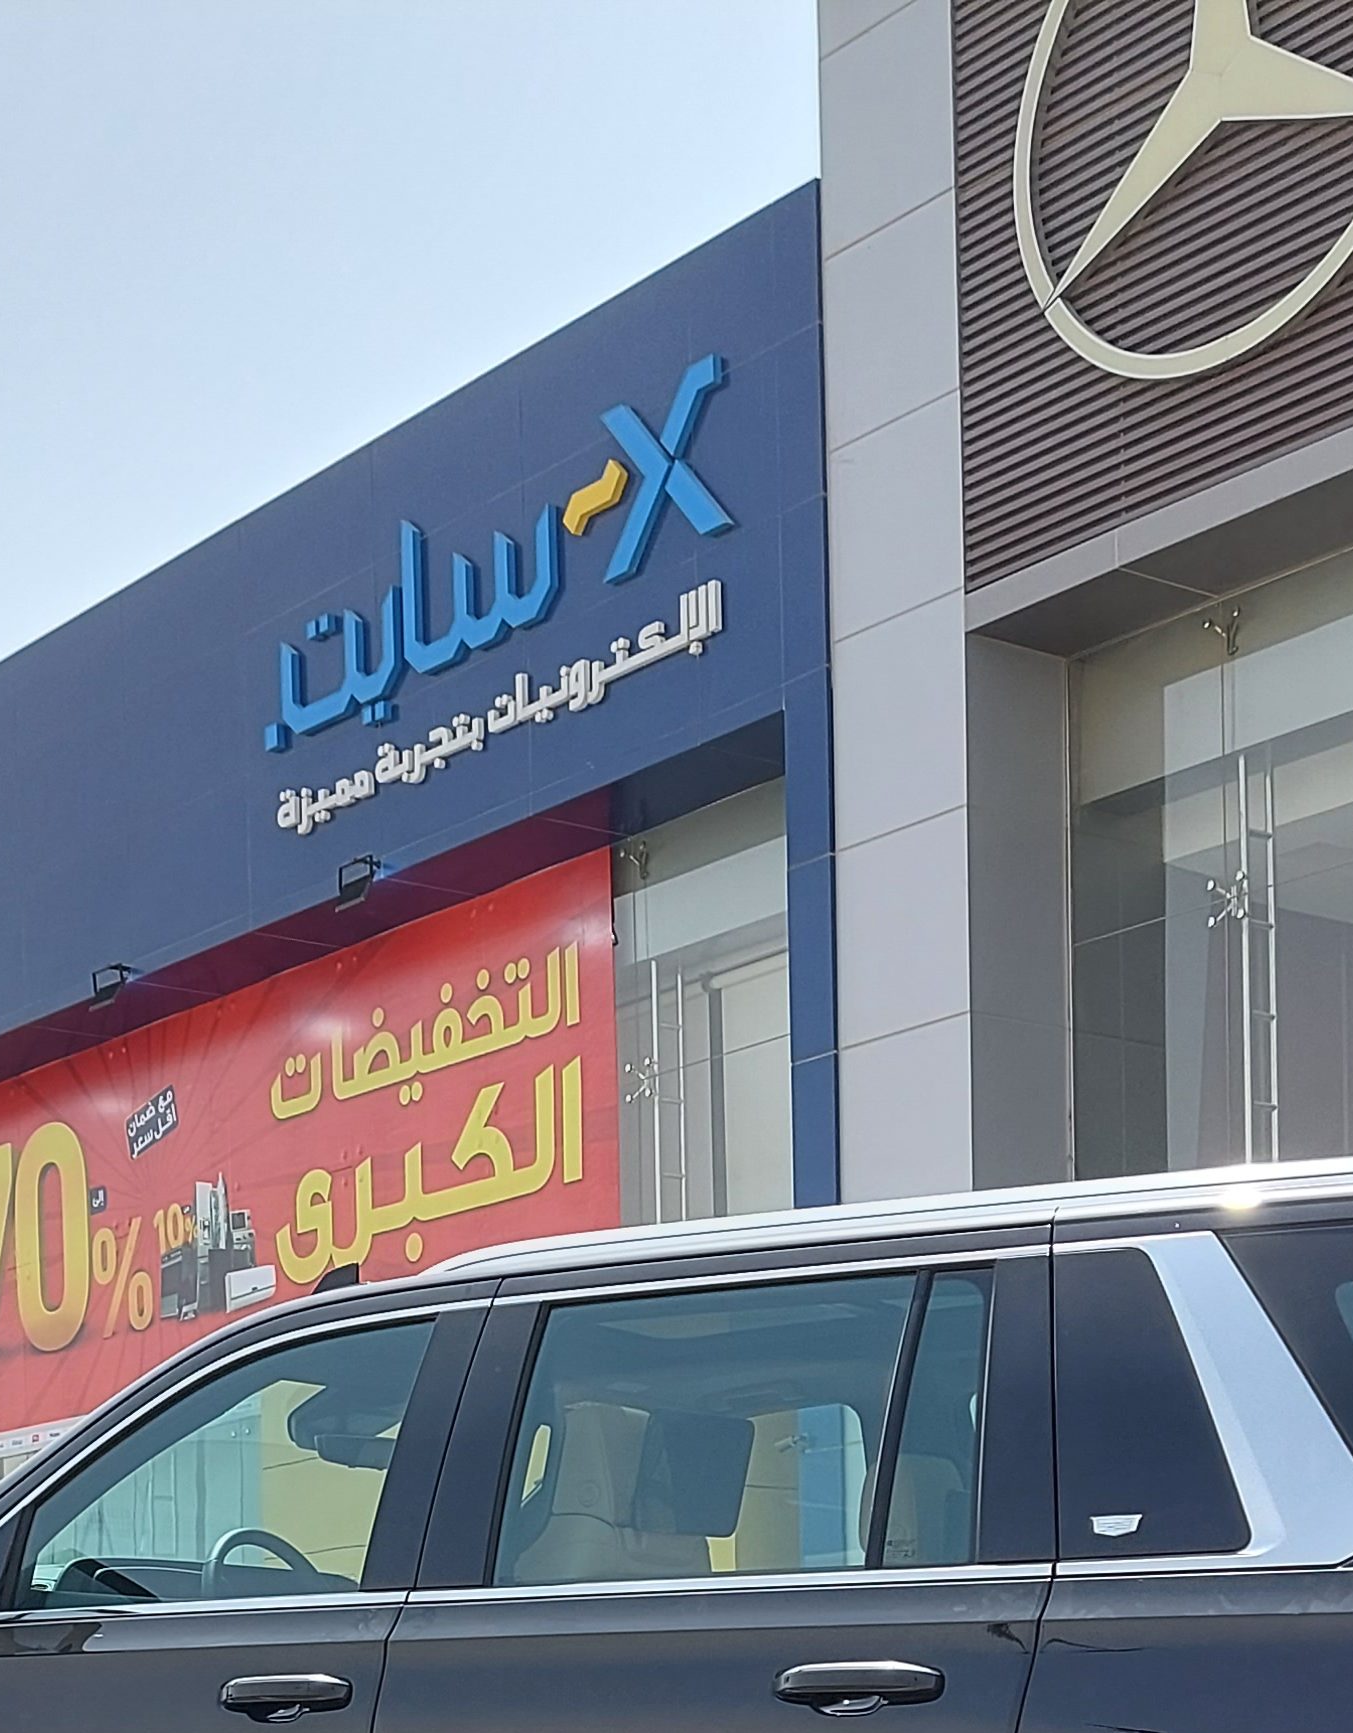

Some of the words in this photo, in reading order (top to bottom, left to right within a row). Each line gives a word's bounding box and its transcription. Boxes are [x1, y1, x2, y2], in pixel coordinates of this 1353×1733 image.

[488, 579, 723, 734] الإلكترونيات
[375, 712, 485, 785] بتجربة
[277, 769, 375, 835] مميزة
[271, 941, 582, 1121] التخفيضات
[128, 1102, 155, 1137] ضمان
[158, 1091, 173, 1113] مع
[133, 1129, 153, 1158] سعر
[275, 1055, 582, 1285] الكبرى
